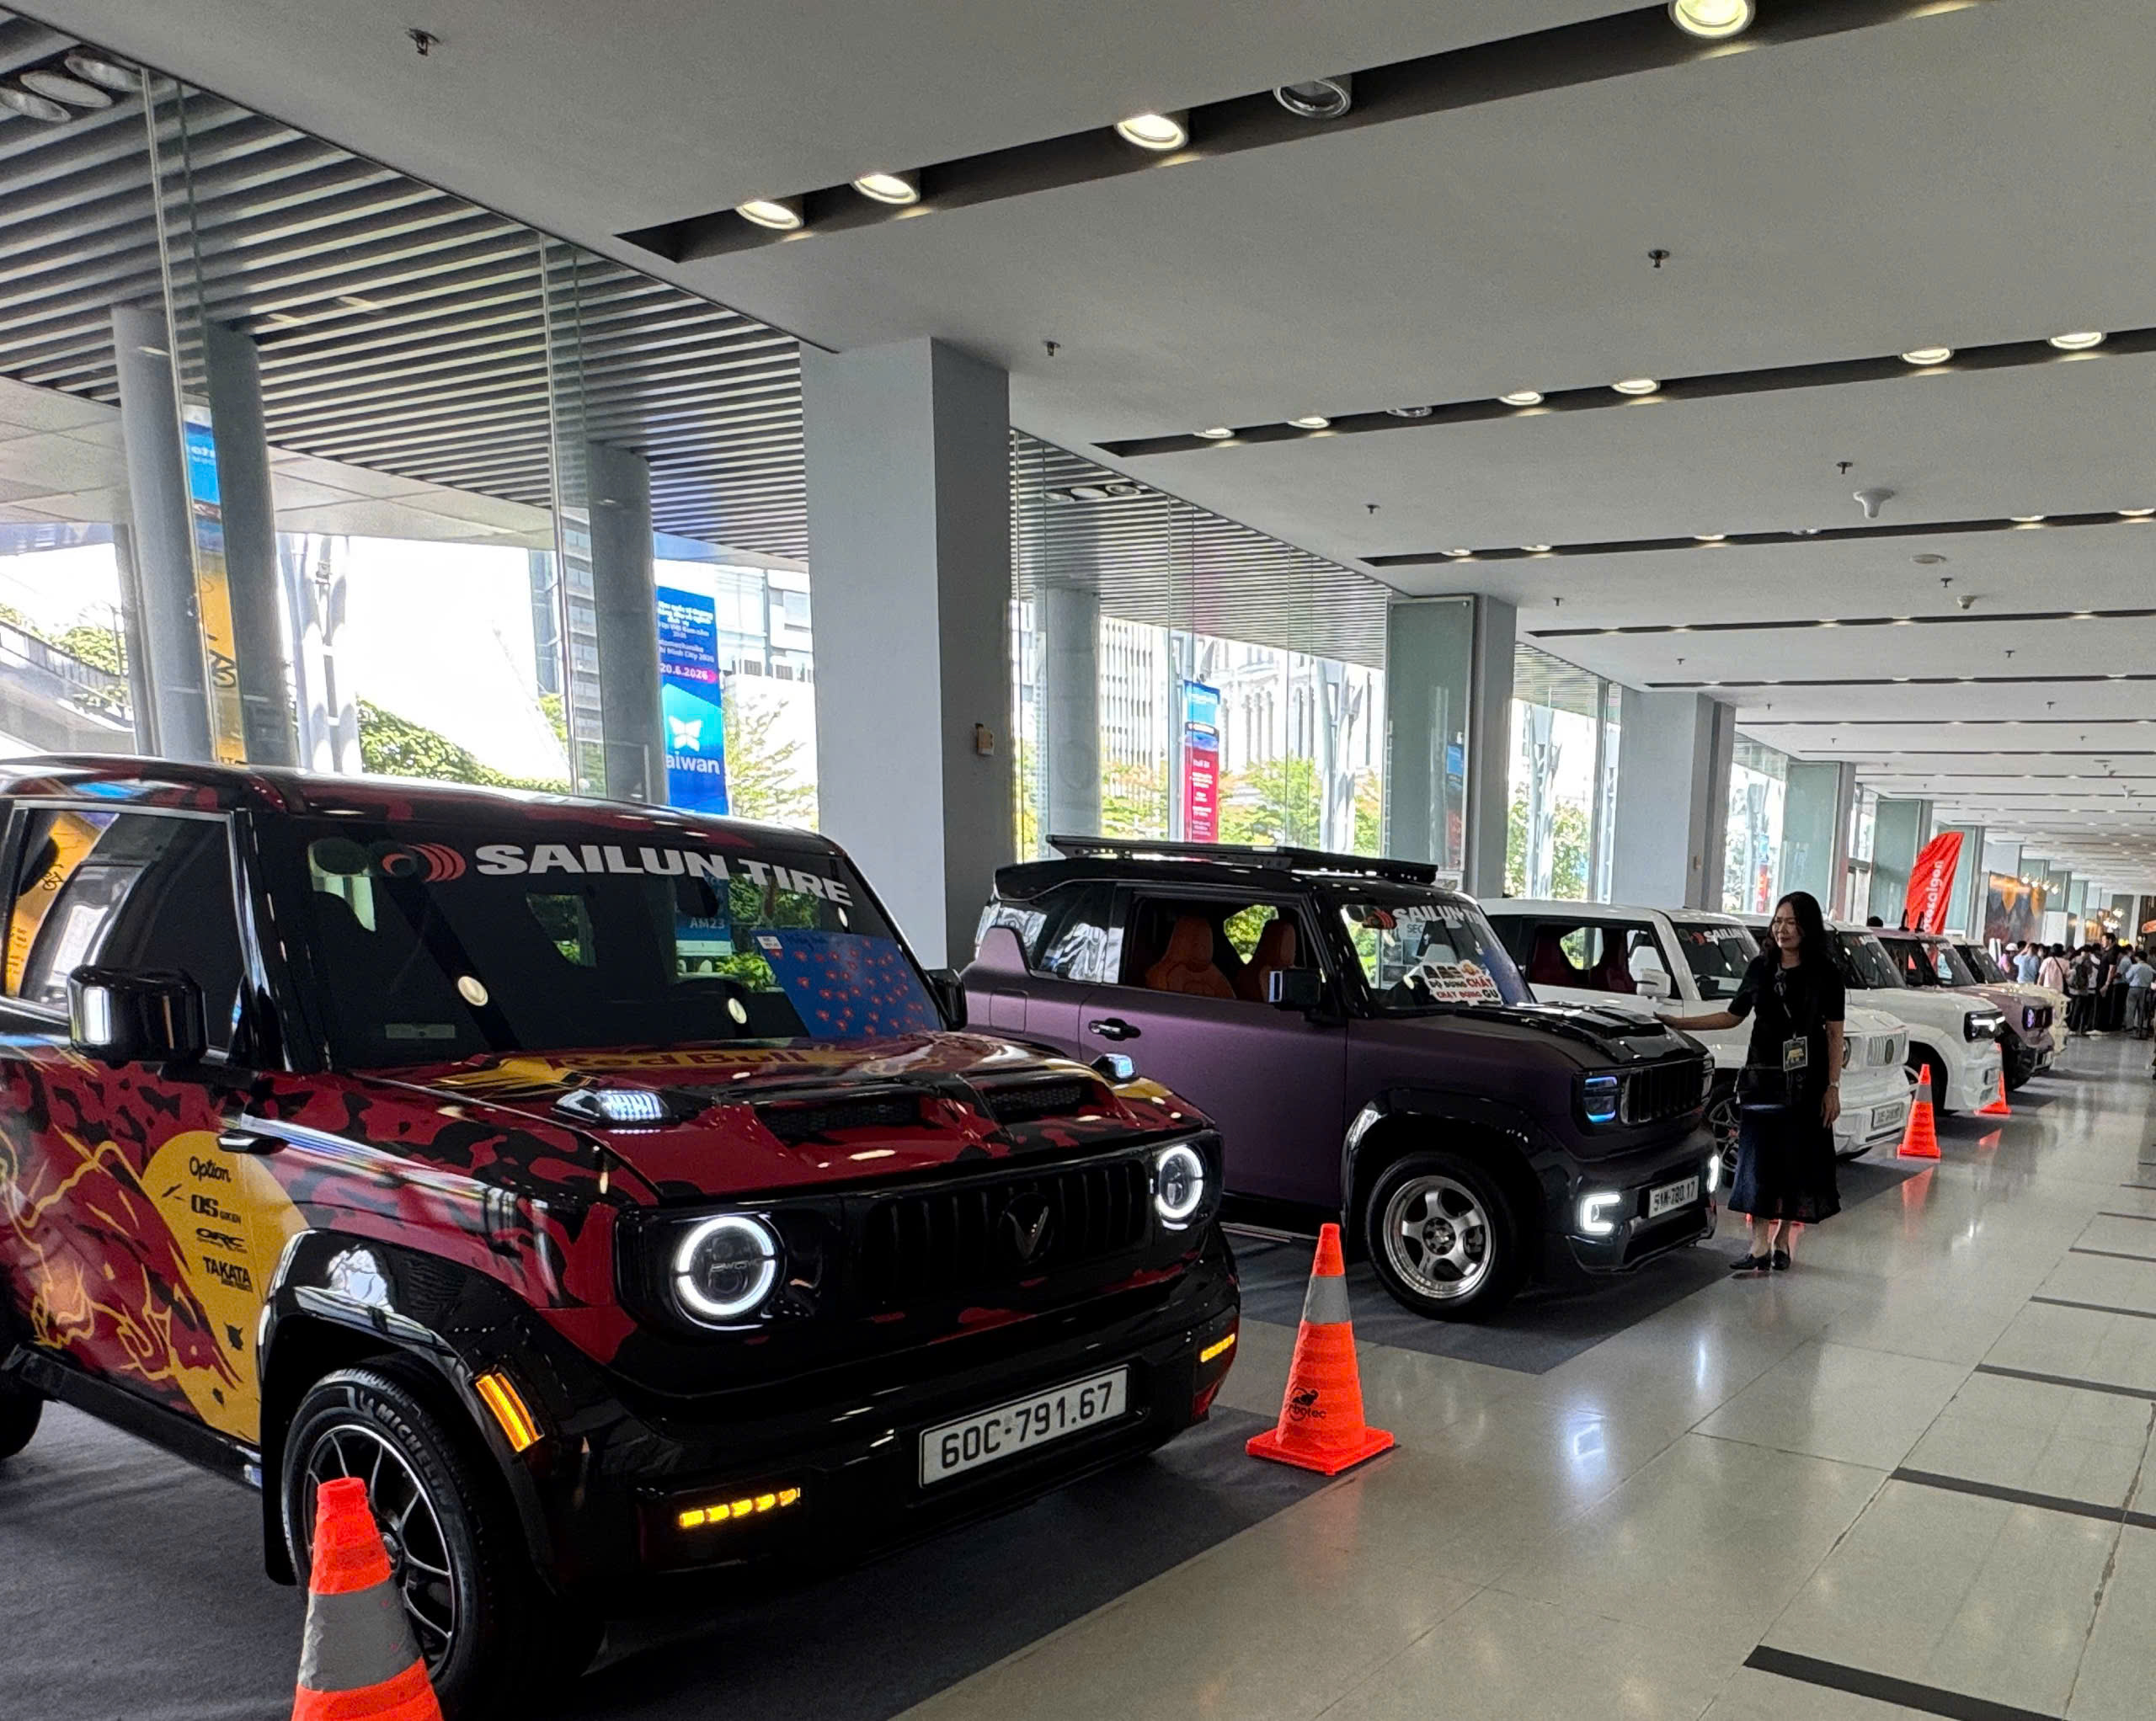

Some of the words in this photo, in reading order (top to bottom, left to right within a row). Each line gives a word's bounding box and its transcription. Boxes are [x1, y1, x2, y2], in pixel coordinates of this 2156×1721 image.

[666, 750, 721, 775] aiwan
[477, 845, 730, 880] SAILUN
[738, 859, 854, 907] TIRE
[1392, 905, 1465, 922] SAILUN
[1482, 989, 1499, 999] GU
[686, 1052, 808, 1064] Bull
[189, 1156, 232, 1183] Option
[191, 1194, 219, 1218] OS
[202, 1255, 252, 1287] TAKATA
[942, 1381, 1113, 1469] 60C-791.67
[376, 1403, 456, 1509] MICHELIN
